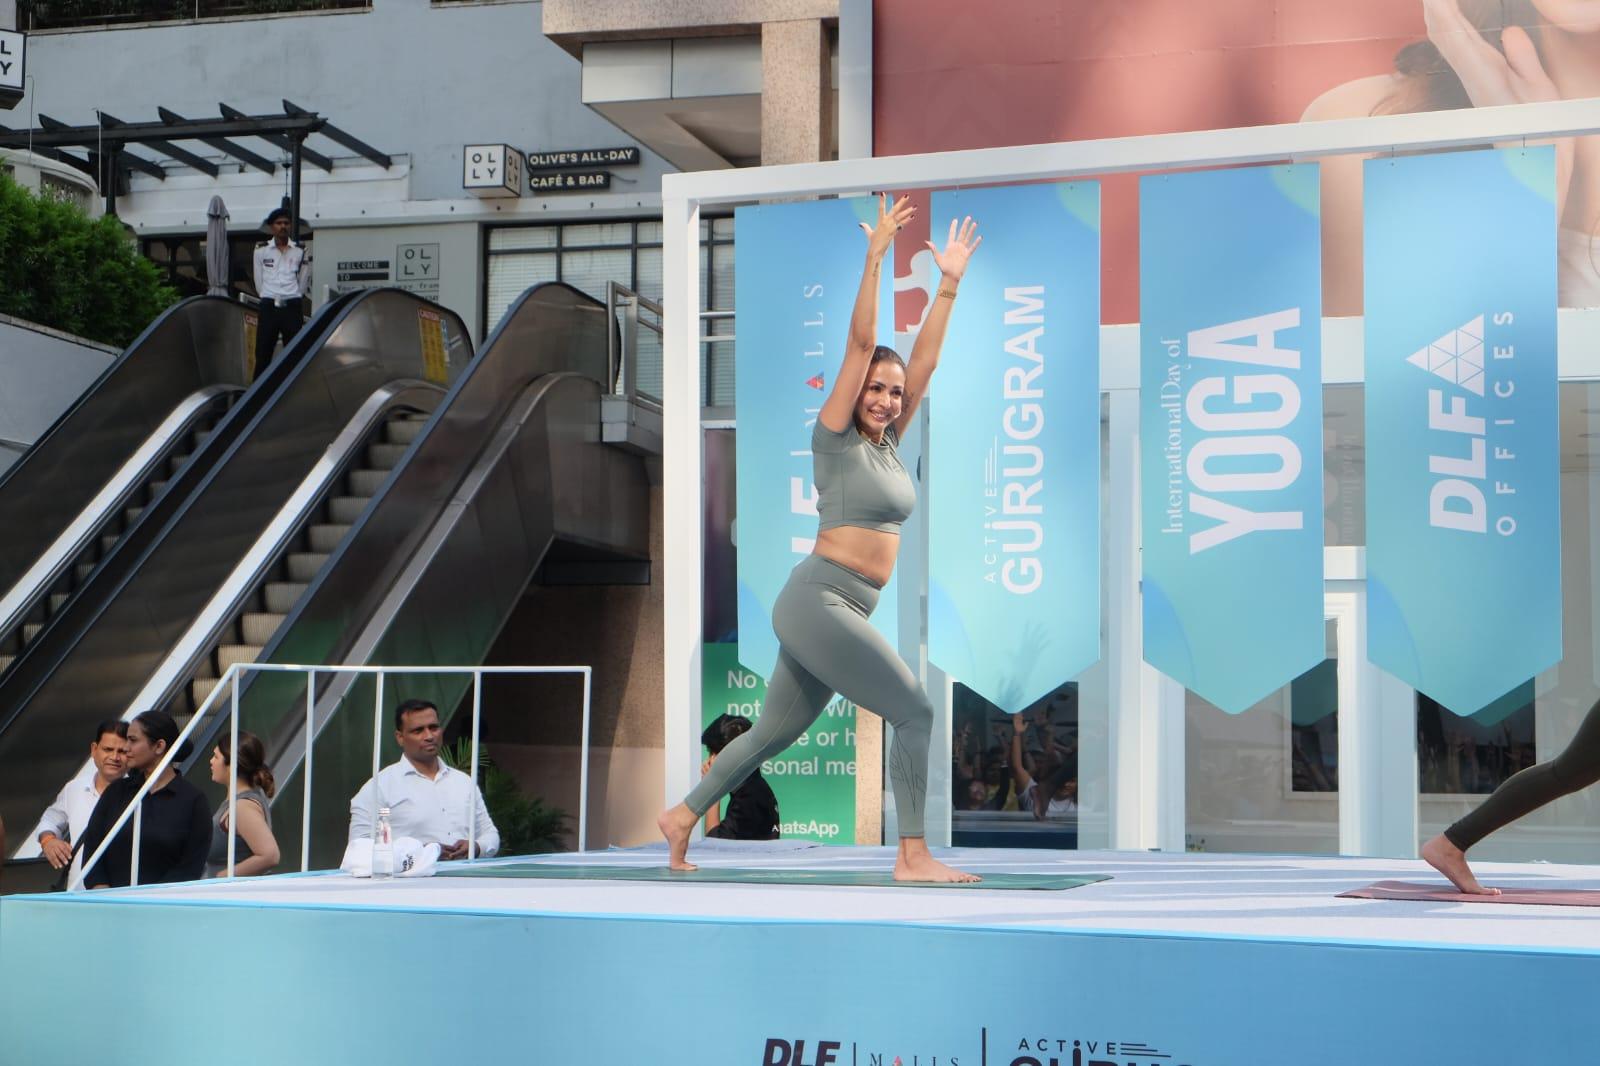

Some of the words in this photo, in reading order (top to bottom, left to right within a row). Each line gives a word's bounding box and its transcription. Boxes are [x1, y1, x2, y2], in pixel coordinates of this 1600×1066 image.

[530, 153, 578, 166] OLIVE'S
[581, 149, 634, 162] ALL-DAY
[530, 173, 563, 187] CAFÉ
[566, 175, 575, 186] &
[579, 174, 604, 185] BAR
[339, 261, 380, 270] WELCOME
[340, 273, 351, 281] TO
[1160, 337, 1182, 357] of
[1160, 363, 1191, 402] Day
[1185, 307, 1304, 555] YOGA
[1493, 311, 1517, 537] OFFICES
[1000, 285, 1045, 595] GURUGRAM
[1160, 403, 1183, 534] International
[1428, 388, 1488, 534] DLF
[727, 670, 757, 689] No
[726, 699, 761, 718] not
[815, 731, 839, 747] or
